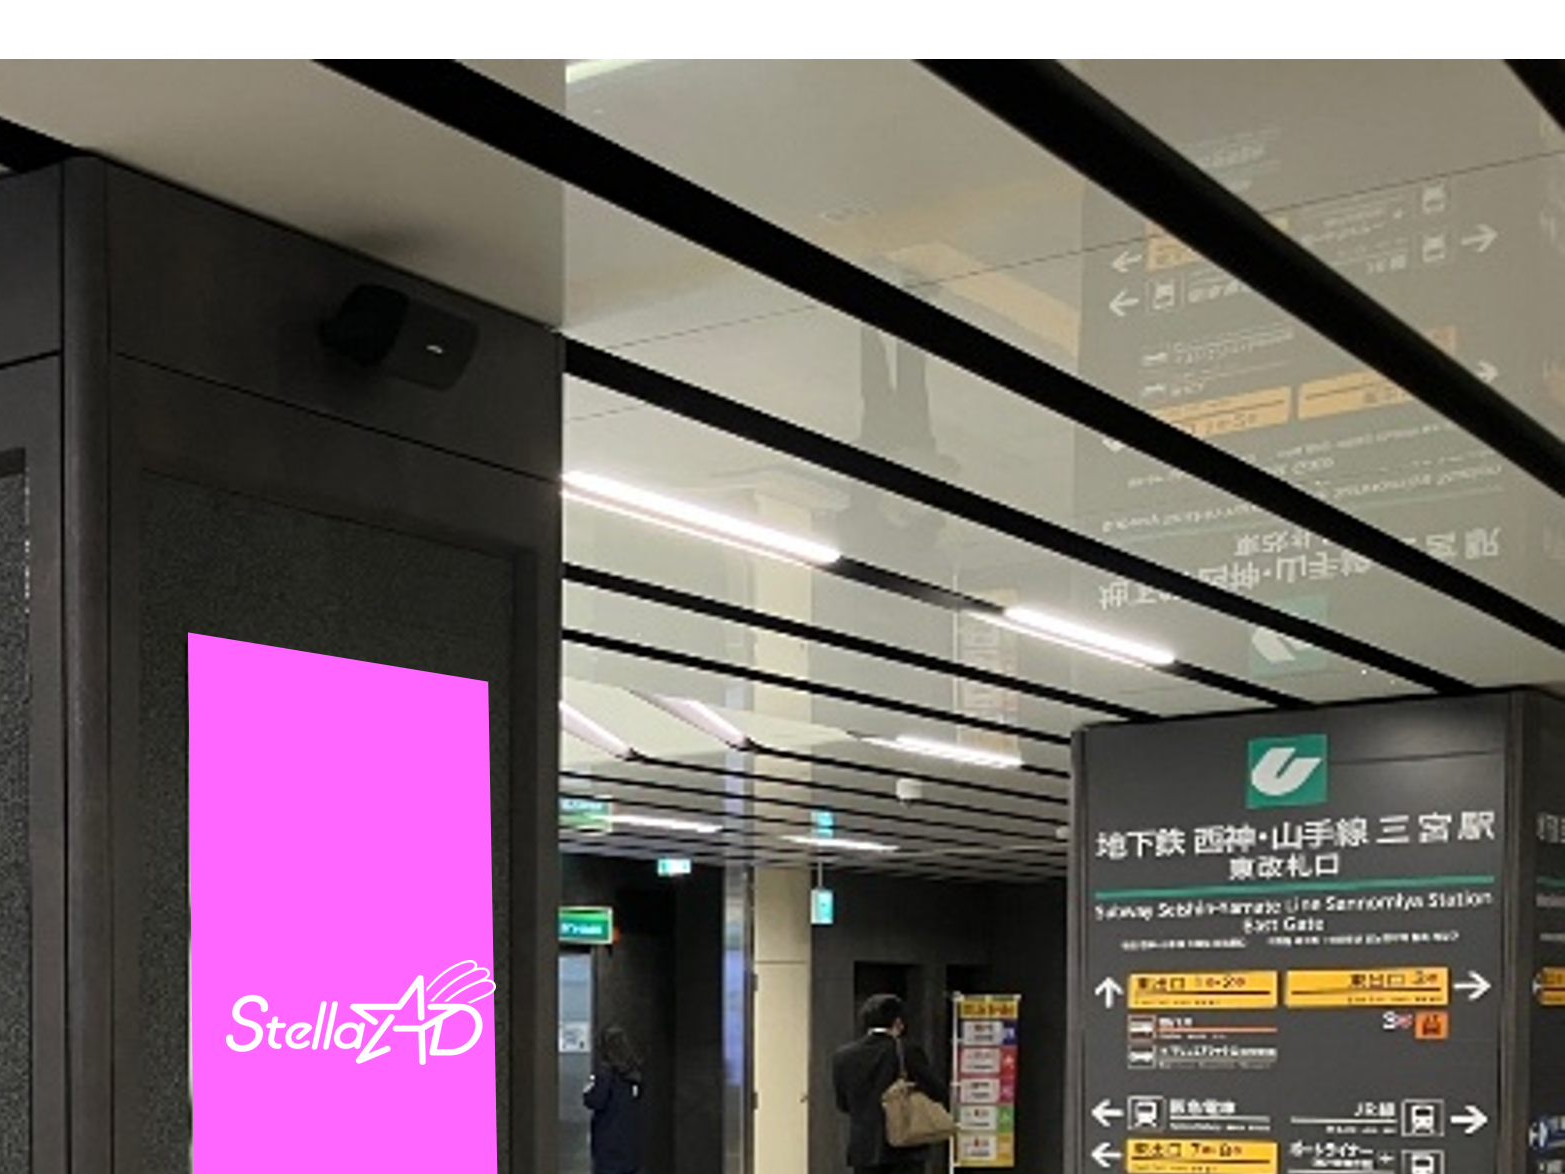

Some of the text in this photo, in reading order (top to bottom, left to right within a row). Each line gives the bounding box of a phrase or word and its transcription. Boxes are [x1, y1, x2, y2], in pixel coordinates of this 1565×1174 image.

[1095, 828, 1185, 859] 地下鉄
[1229, 852, 1338, 879] 東改札口
[1428, 889, 1492, 908] Station
[1283, 916, 1324, 932] Gate
